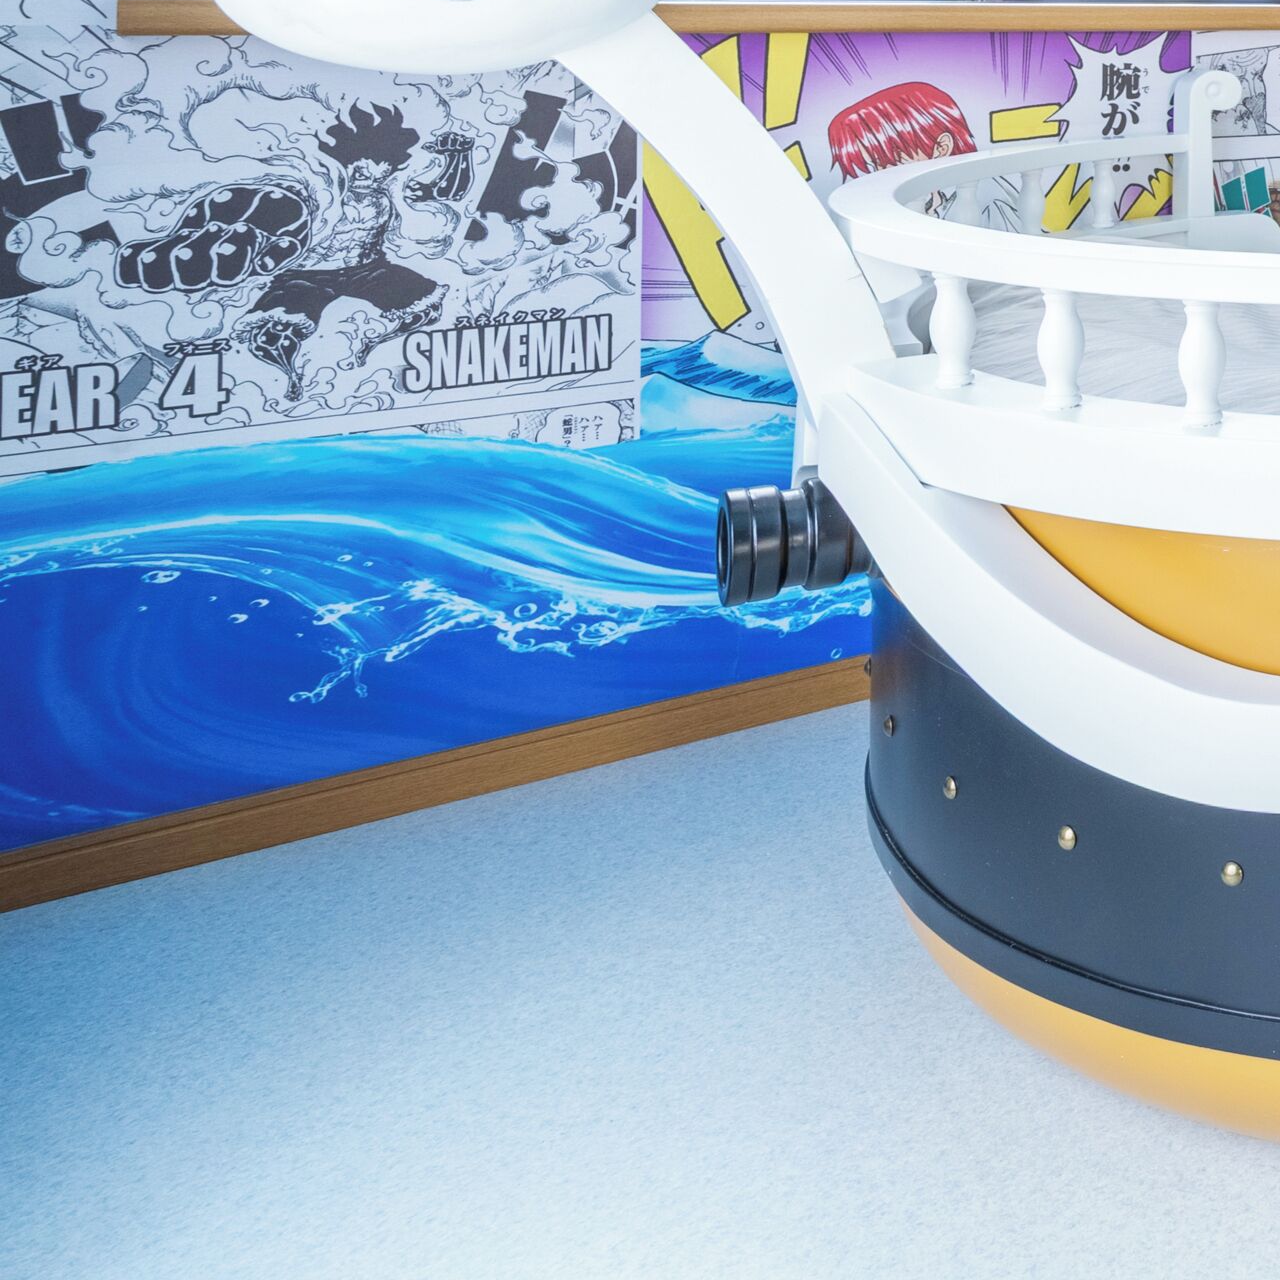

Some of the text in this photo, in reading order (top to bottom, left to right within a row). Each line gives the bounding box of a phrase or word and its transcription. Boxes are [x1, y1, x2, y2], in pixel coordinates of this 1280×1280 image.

[403, 313, 614, 394] SNAKEMAN
[456, 307, 567, 328] スネイクマン
[0, 362, 119, 438] EAR
[158, 349, 231, 419] 4
